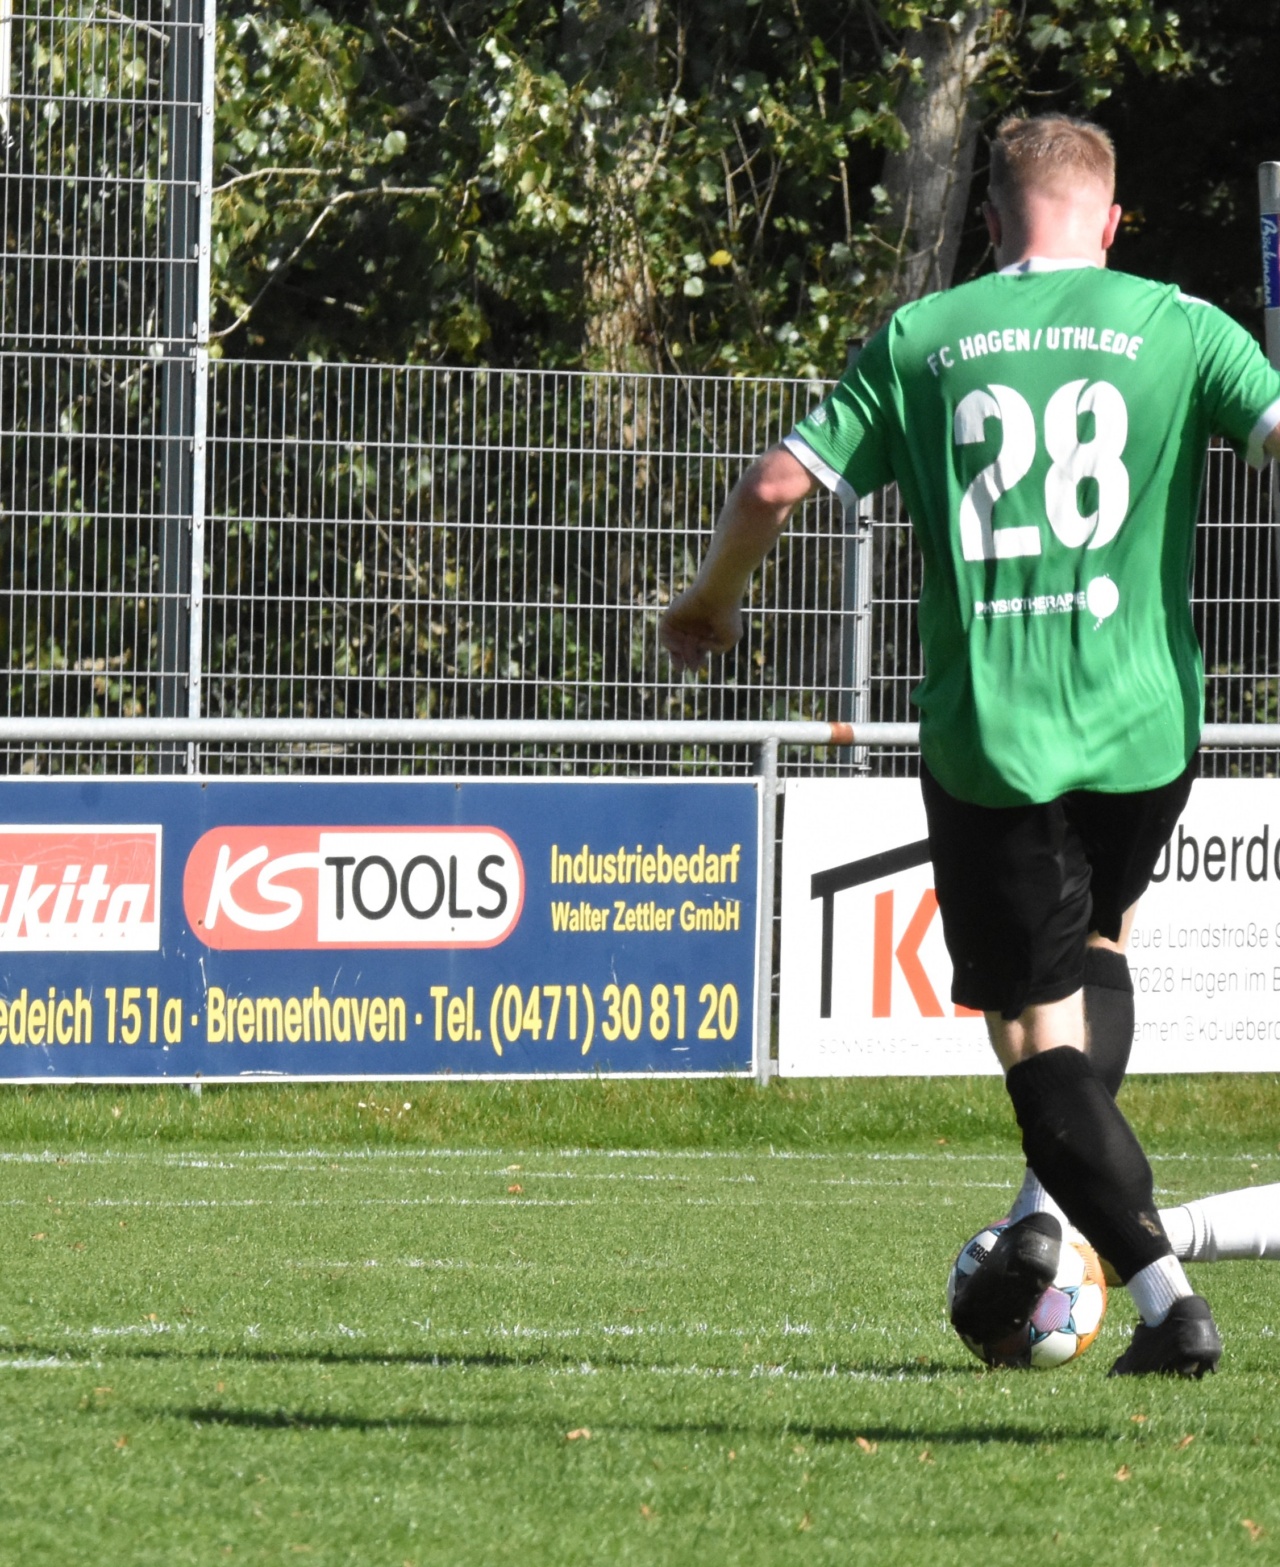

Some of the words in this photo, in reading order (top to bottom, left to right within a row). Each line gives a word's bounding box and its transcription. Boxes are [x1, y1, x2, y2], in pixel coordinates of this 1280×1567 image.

[926, 346, 955, 377] FC
[954, 378, 1130, 562] 28
[551, 844, 742, 884] Industriebedarf
[0, 864, 151, 924] kita
[204, 844, 319, 932] KS
[324, 855, 508, 921] TOOLS
[551, 901, 610, 932] Walter
[612, 901, 676, 932] Zettler
[679, 900, 740, 932] GmbH
[1130, 926, 1163, 949] eue
[1168, 921, 1270, 949] Landstraße
[1129, 966, 1175, 993] 7628
[1181, 966, 1239, 999] Hagen
[1244, 966, 1266, 991] im
[104, 987, 182, 1045] 151a
[207, 986, 407, 1043] Bremerhaven
[430, 986, 482, 1042] Tel.
[489, 983, 595, 1056] (0471)
[602, 983, 643, 1041] 30
[649, 983, 686, 1041] 81
[697, 983, 739, 1041] 20
